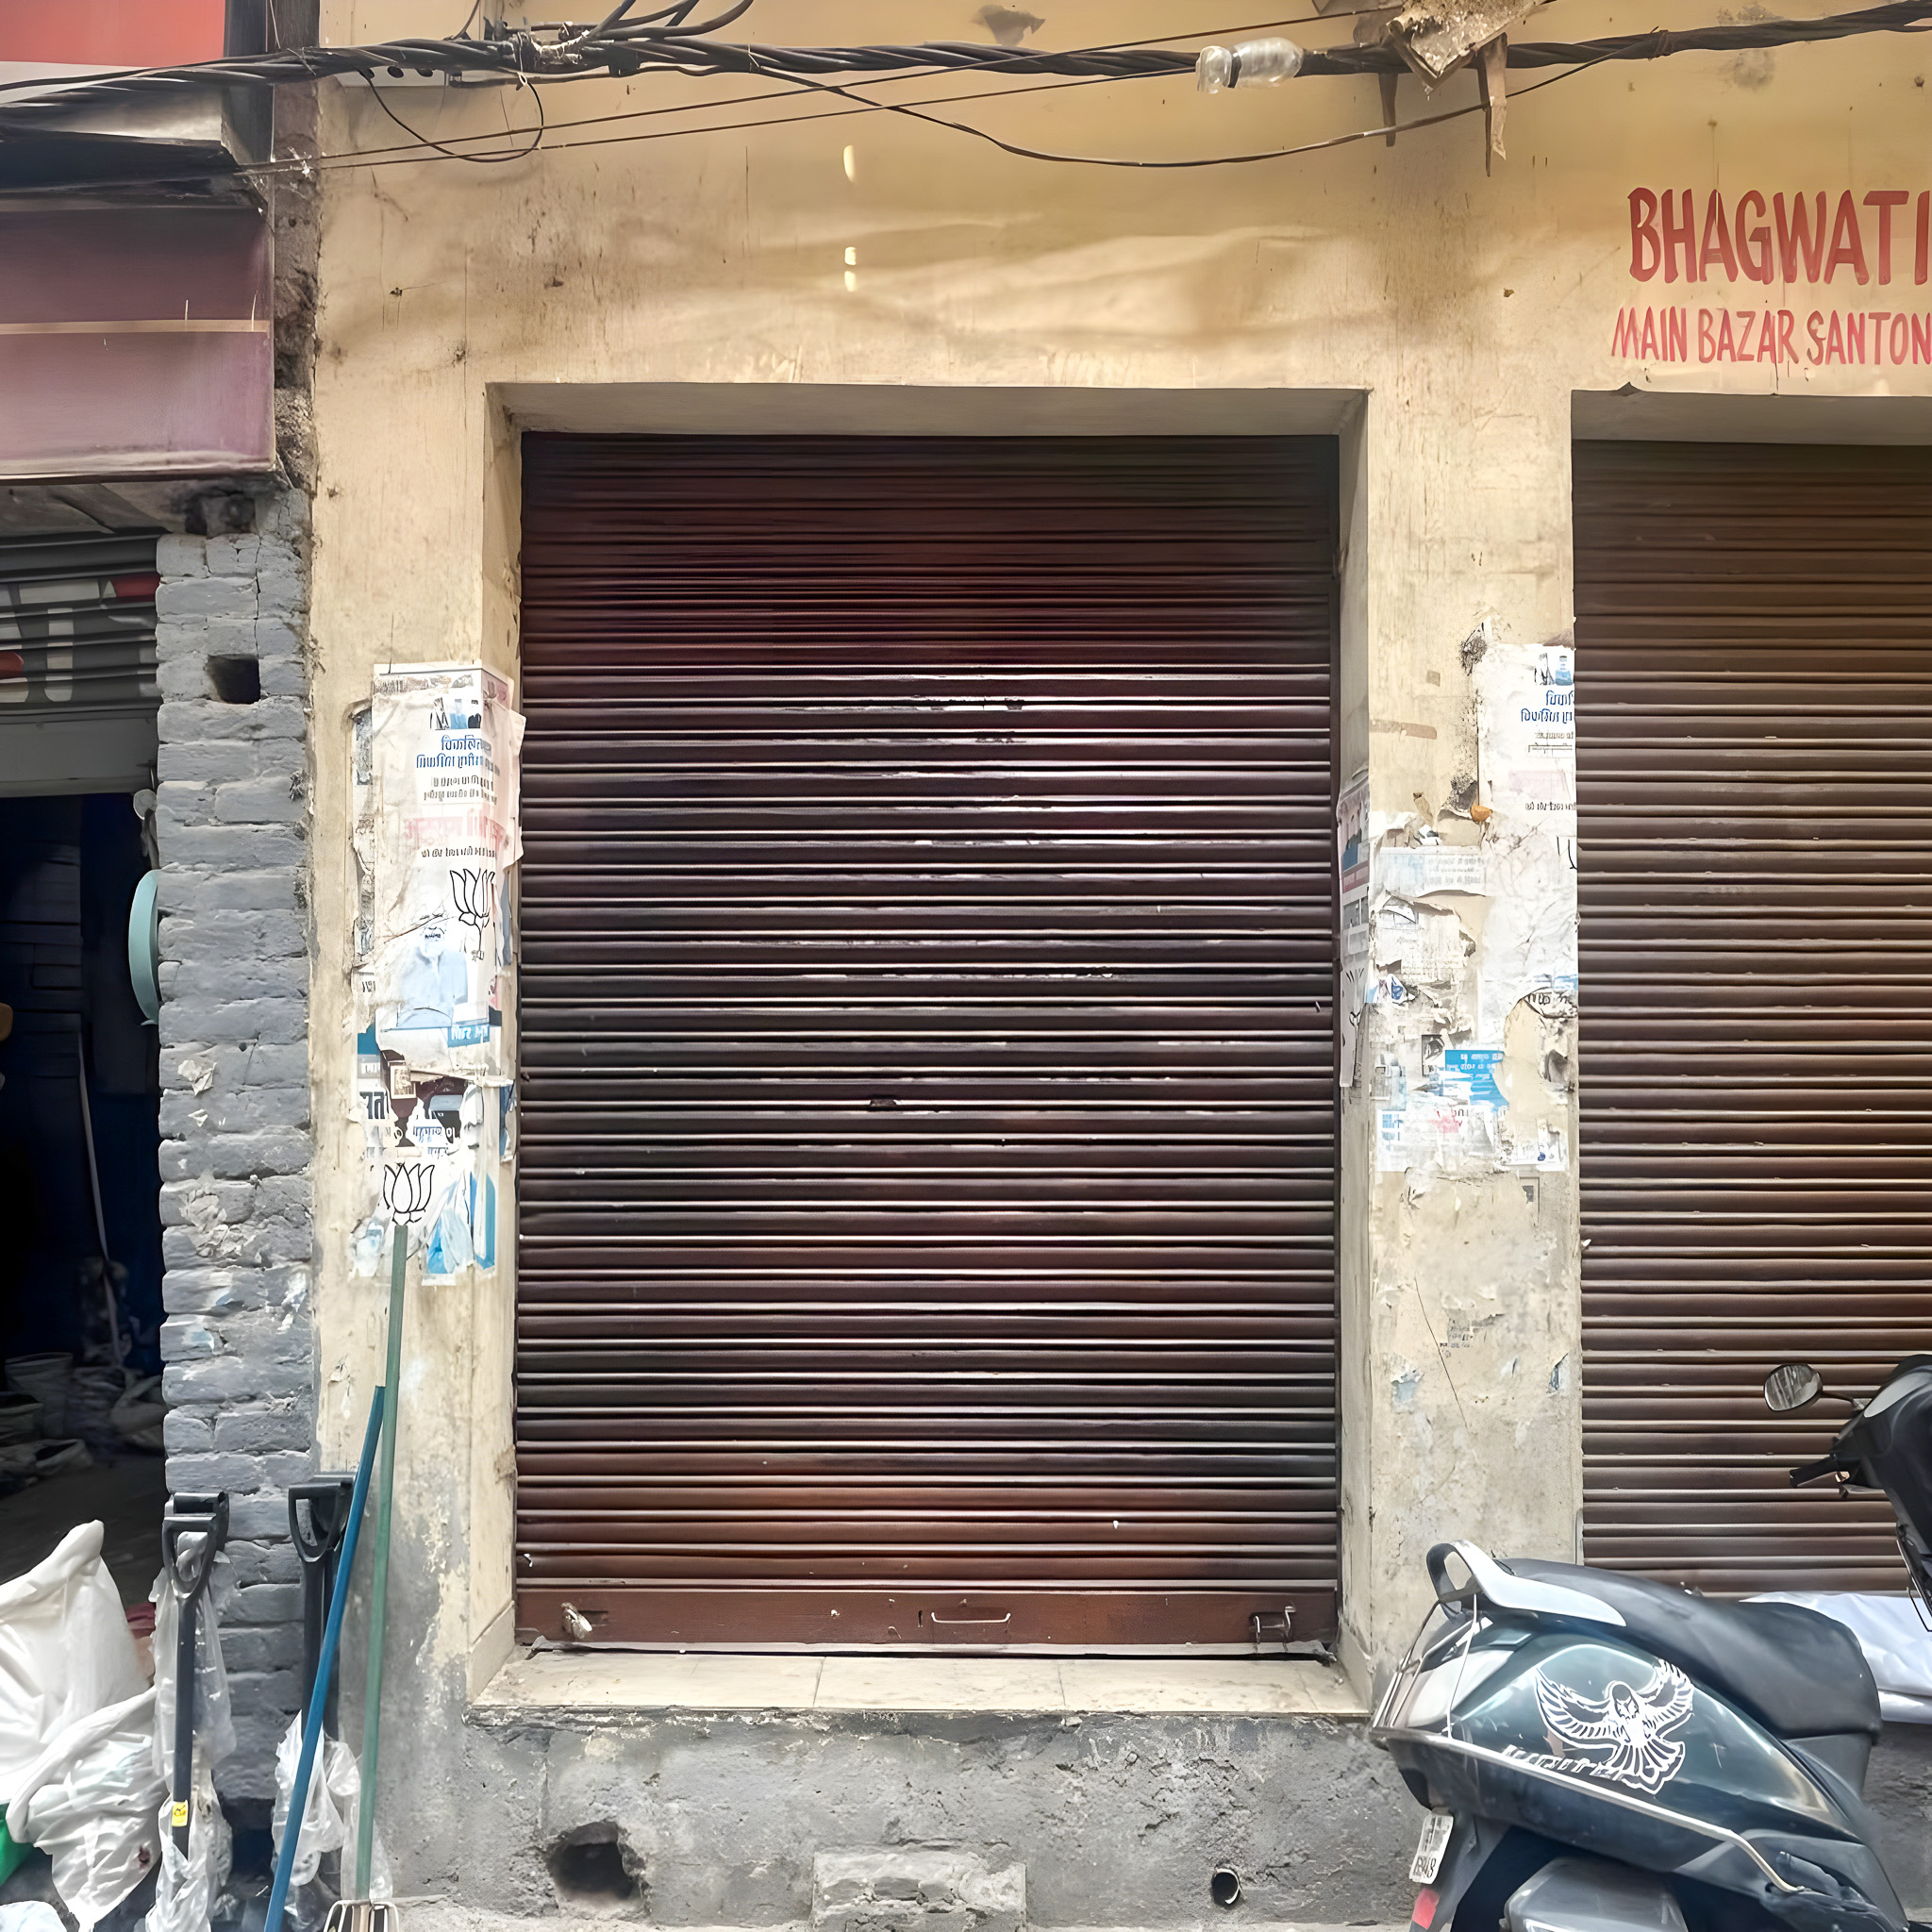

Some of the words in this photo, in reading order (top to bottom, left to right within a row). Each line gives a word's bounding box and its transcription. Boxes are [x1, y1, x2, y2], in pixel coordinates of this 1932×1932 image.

[1627, 187, 1930, 286] BHAGWATI
[1611, 306, 1687, 363] MAIN
[1698, 308, 1800, 364] BAZAR
[1807, 309, 1931, 366] SANTON
